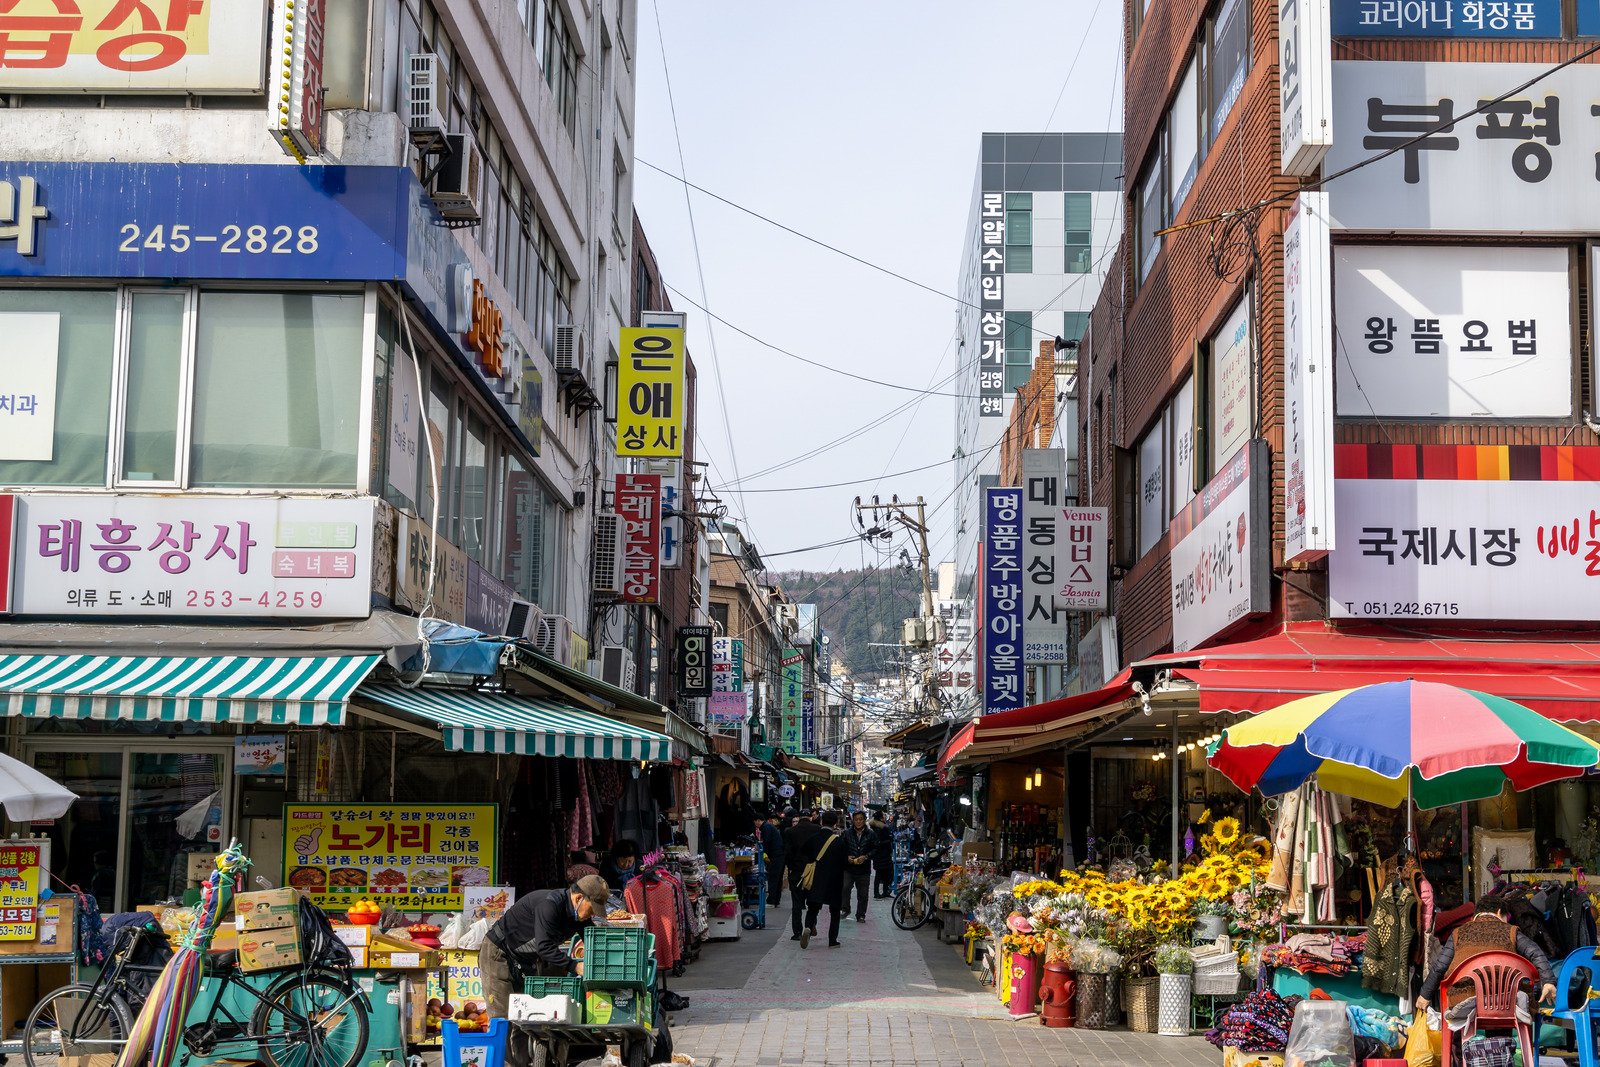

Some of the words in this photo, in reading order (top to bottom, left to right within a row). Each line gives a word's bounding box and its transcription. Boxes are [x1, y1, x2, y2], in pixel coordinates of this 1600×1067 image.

[1358, 0, 1452, 28] 코리아나
[1461, 1, 1536, 30] 화장품
[1362, 95, 1600, 184] 부평
[119, 223, 320, 255] 245-2828
[980, 371, 1003, 389] 김영
[980, 397, 1003, 415] 상회
[622, 425, 678, 450] 상사
[1062, 509, 1102, 521] Venus
[619, 475, 657, 596] 노래연습장
[37, 518, 258, 575] 태흥상사
[1068, 525, 1093, 583] 비너스
[1358, 526, 1521, 567] 국제시장
[278, 554, 351, 576] 숙녀복
[66, 588, 98, 608] 의류
[186, 589, 323, 609] 253-4259
[989, 493, 1022, 702] 명품주방아울렛
[1065, 598, 1098, 608] 자스민
[1363, 602, 1459, 616] 051.242.6715
[1026, 643, 1064, 651] 242-9114
[1026, 652, 1065, 661] 245-2588
[400, 811, 421, 821] 정말
[327, 823, 432, 853] 노가리
[444, 825, 472, 838] 각종
[439, 840, 480, 853] 건어물
[20, 851, 36, 865] 강황
[313, 896, 353, 906] 맛으로
